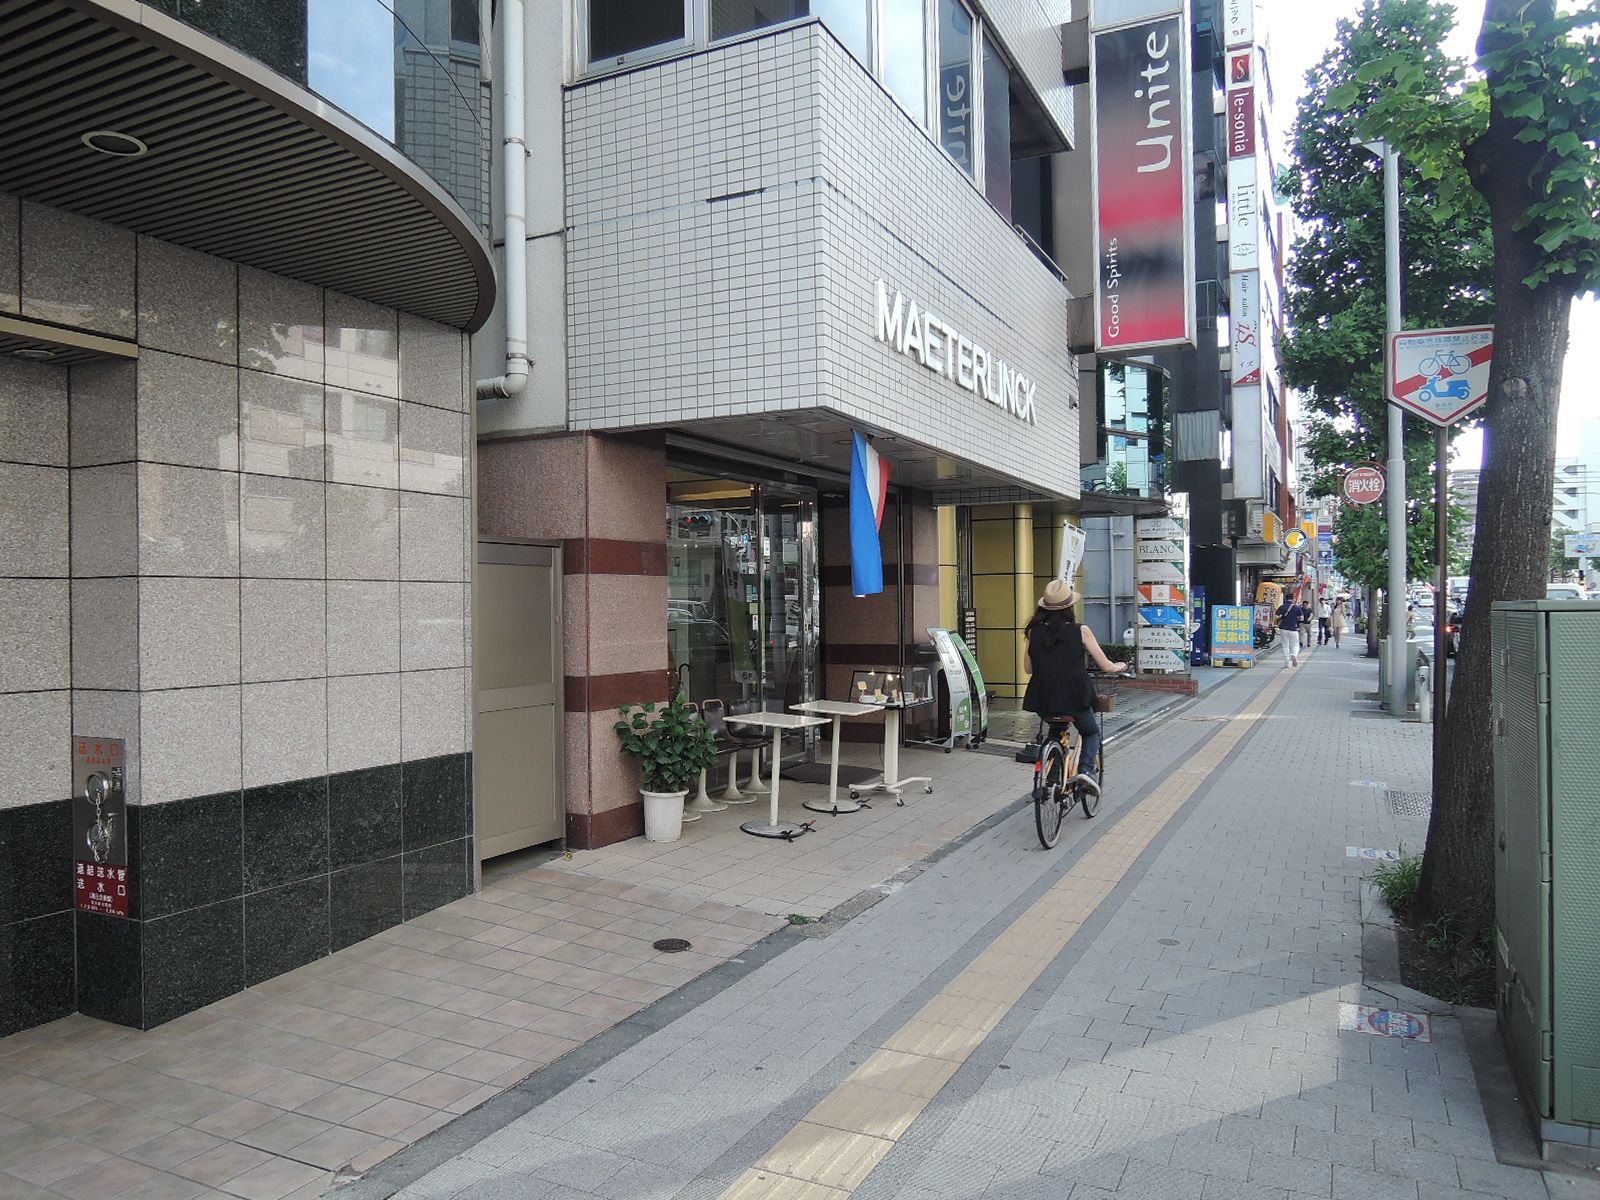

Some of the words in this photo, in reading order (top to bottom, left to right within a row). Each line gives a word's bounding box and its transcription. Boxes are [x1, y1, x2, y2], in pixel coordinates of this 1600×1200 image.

[1135, 30, 1175, 173] Unite
[1234, 92, 1250, 152] le-sonia
[1238, 184, 1255, 227] little
[1107, 237, 1122, 289] Spirits
[1108, 293, 1120, 338] Good
[874, 277, 1038, 425] MAETERLINCK
[1348, 477, 1380, 493] 消火栓
[1139, 545, 1175, 554] BLANC
